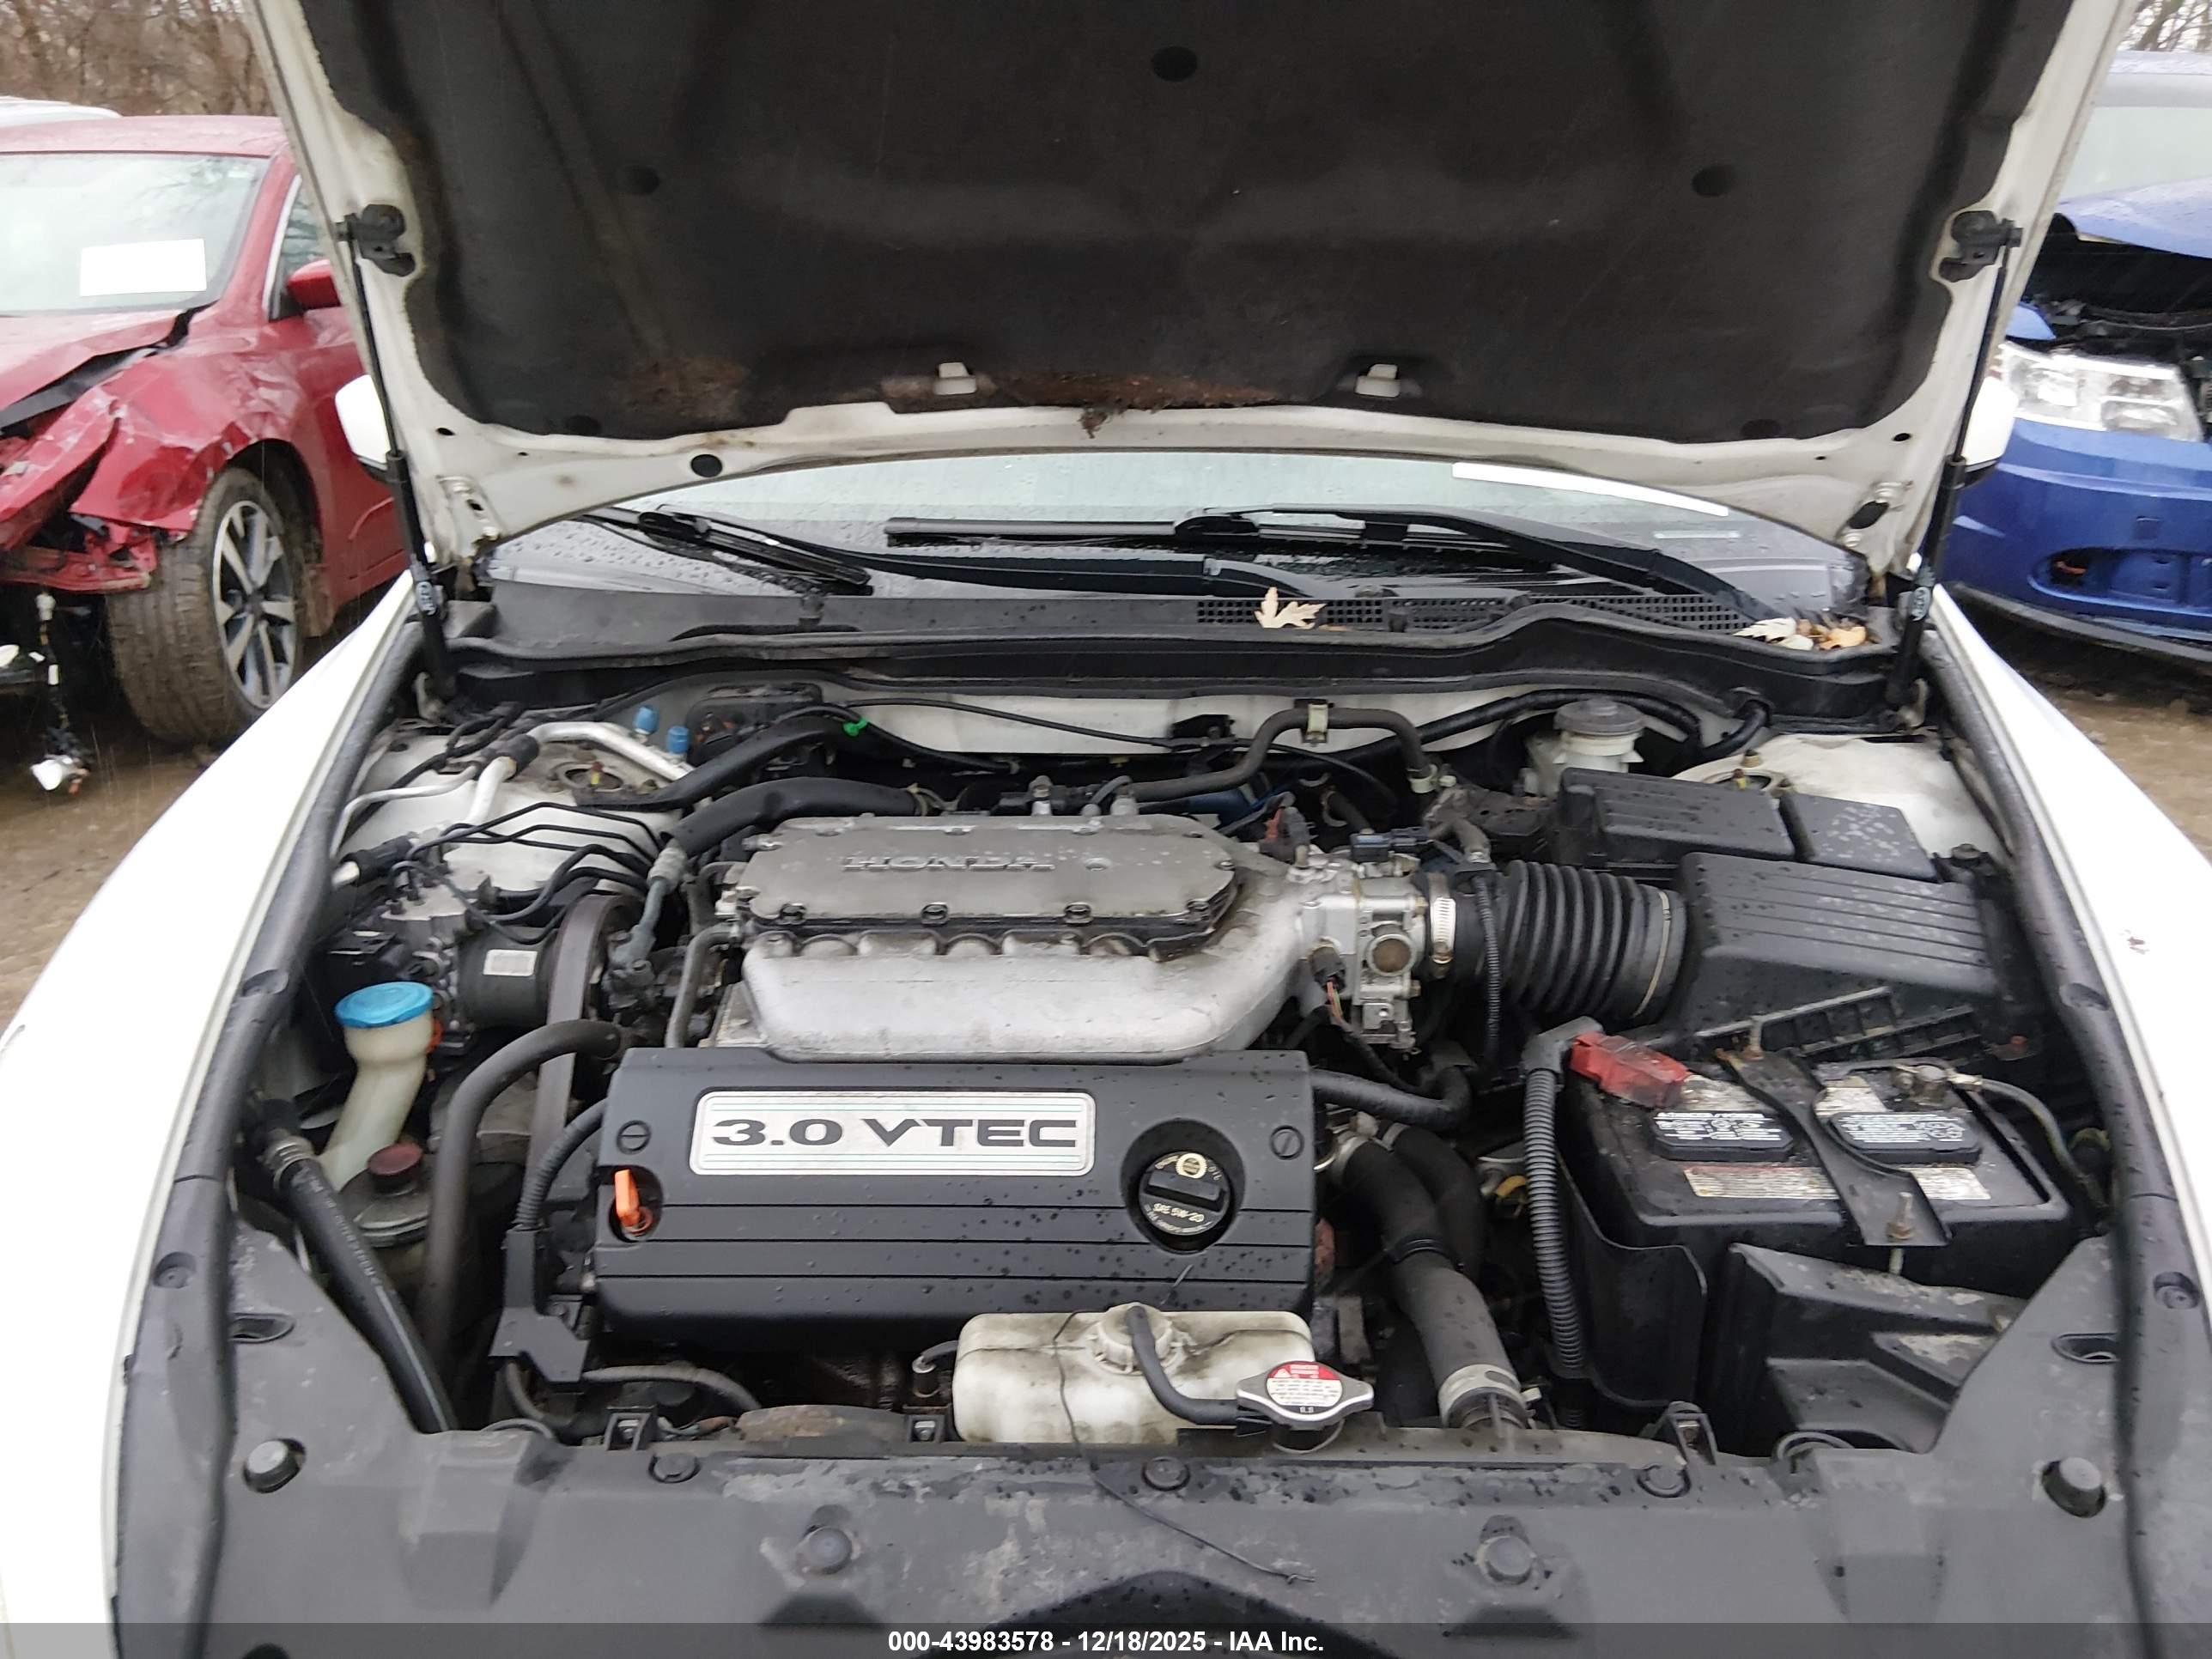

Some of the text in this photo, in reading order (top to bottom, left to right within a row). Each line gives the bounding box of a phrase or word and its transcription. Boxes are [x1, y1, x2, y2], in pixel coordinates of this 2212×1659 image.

[842, 856, 1055, 872] HONDA
[712, 1117, 1077, 1148] 3.0 VTEC
